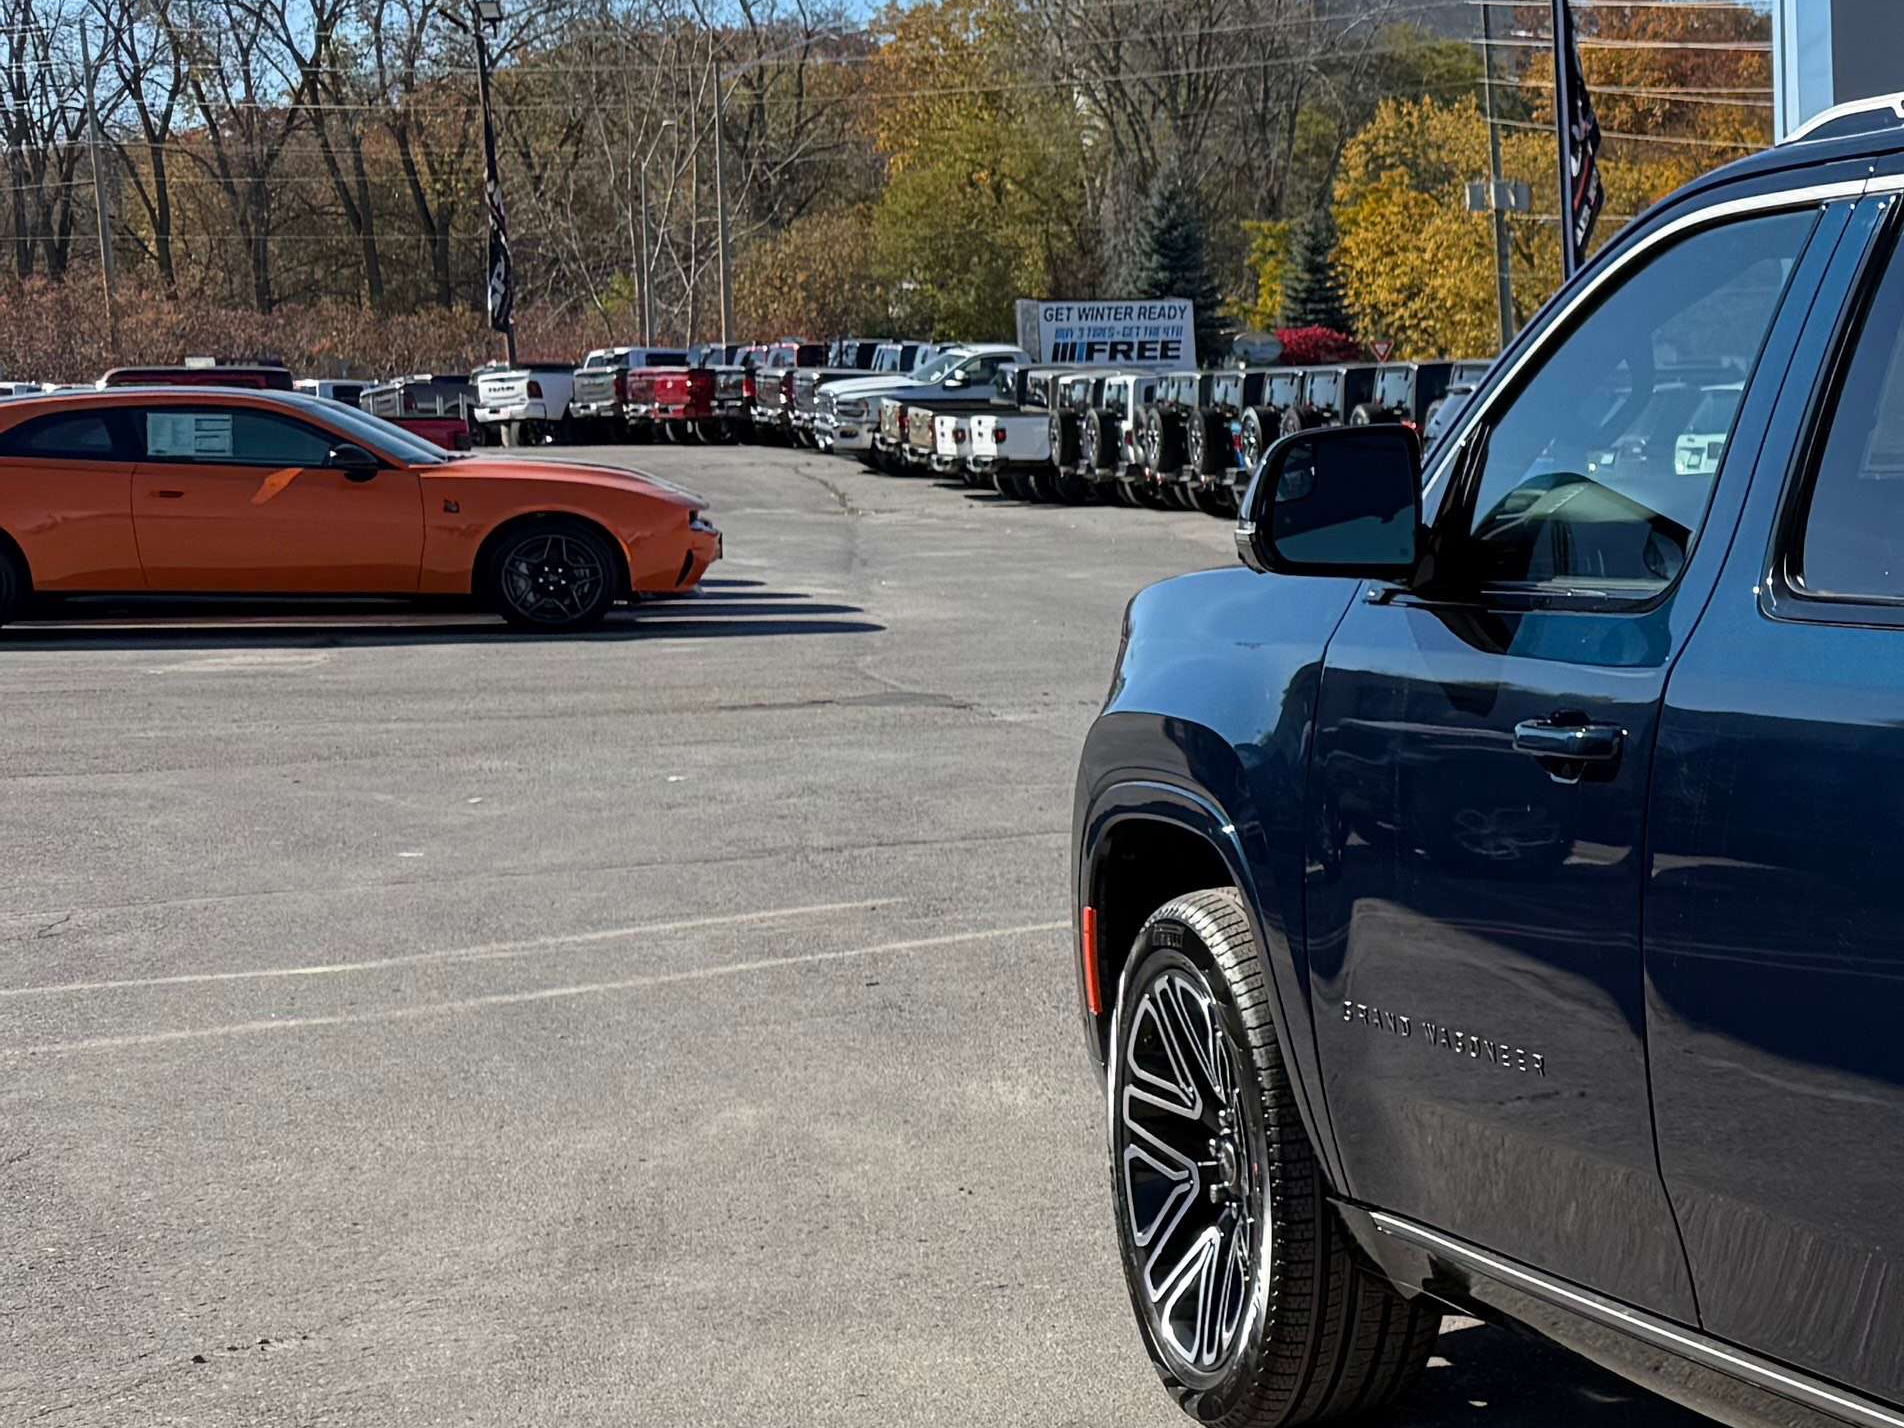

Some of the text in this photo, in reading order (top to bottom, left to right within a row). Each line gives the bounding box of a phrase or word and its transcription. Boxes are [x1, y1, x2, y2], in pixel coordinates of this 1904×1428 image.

[1043, 304, 1188, 323] GET WINTER READY
[1085, 340, 1182, 362] FREE
[1343, 1000, 1546, 1078] GRAND WAGONEER
